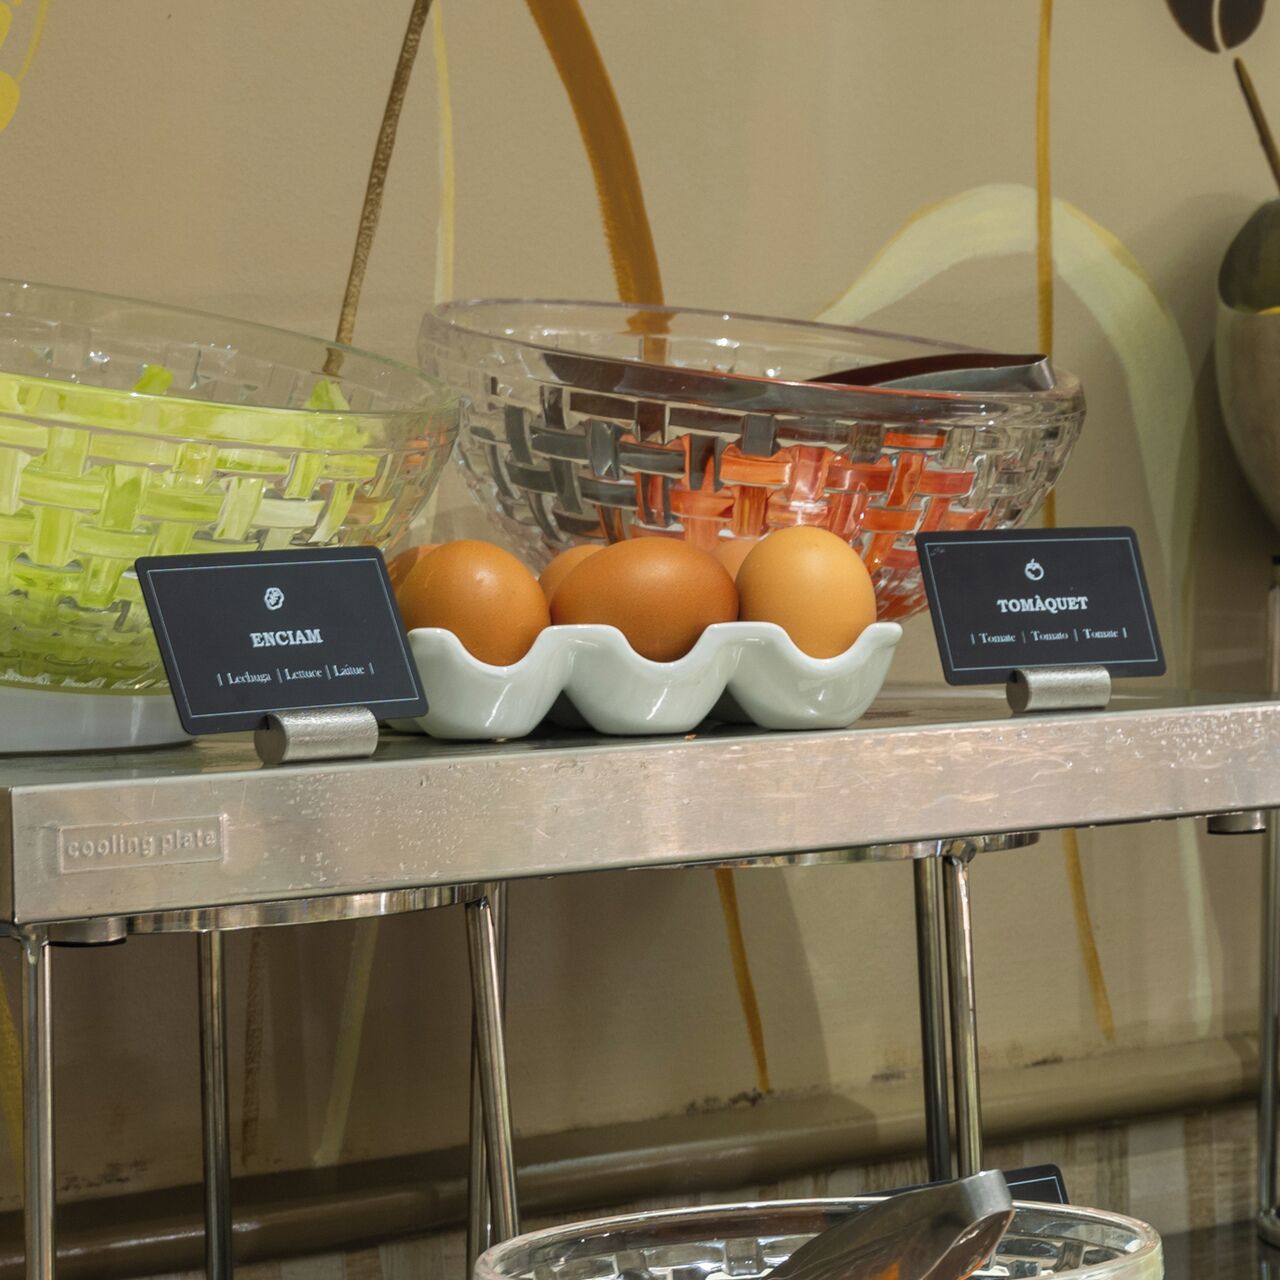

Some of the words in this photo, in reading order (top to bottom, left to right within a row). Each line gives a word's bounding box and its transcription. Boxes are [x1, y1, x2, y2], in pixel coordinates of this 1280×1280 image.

[997, 594, 1088, 614] TOMÀQUET
[250, 629, 323, 648] ENCIAM
[978, 632, 1016, 644] Tomate
[1030, 630, 1068, 642] Tomato
[1082, 627, 1118, 640] Tomate
[227, 672, 272, 685] Lechuga
[284, 668, 322, 681] Lettuce
[68, 833, 153, 858] cooling
[162, 829, 217, 855] plate
